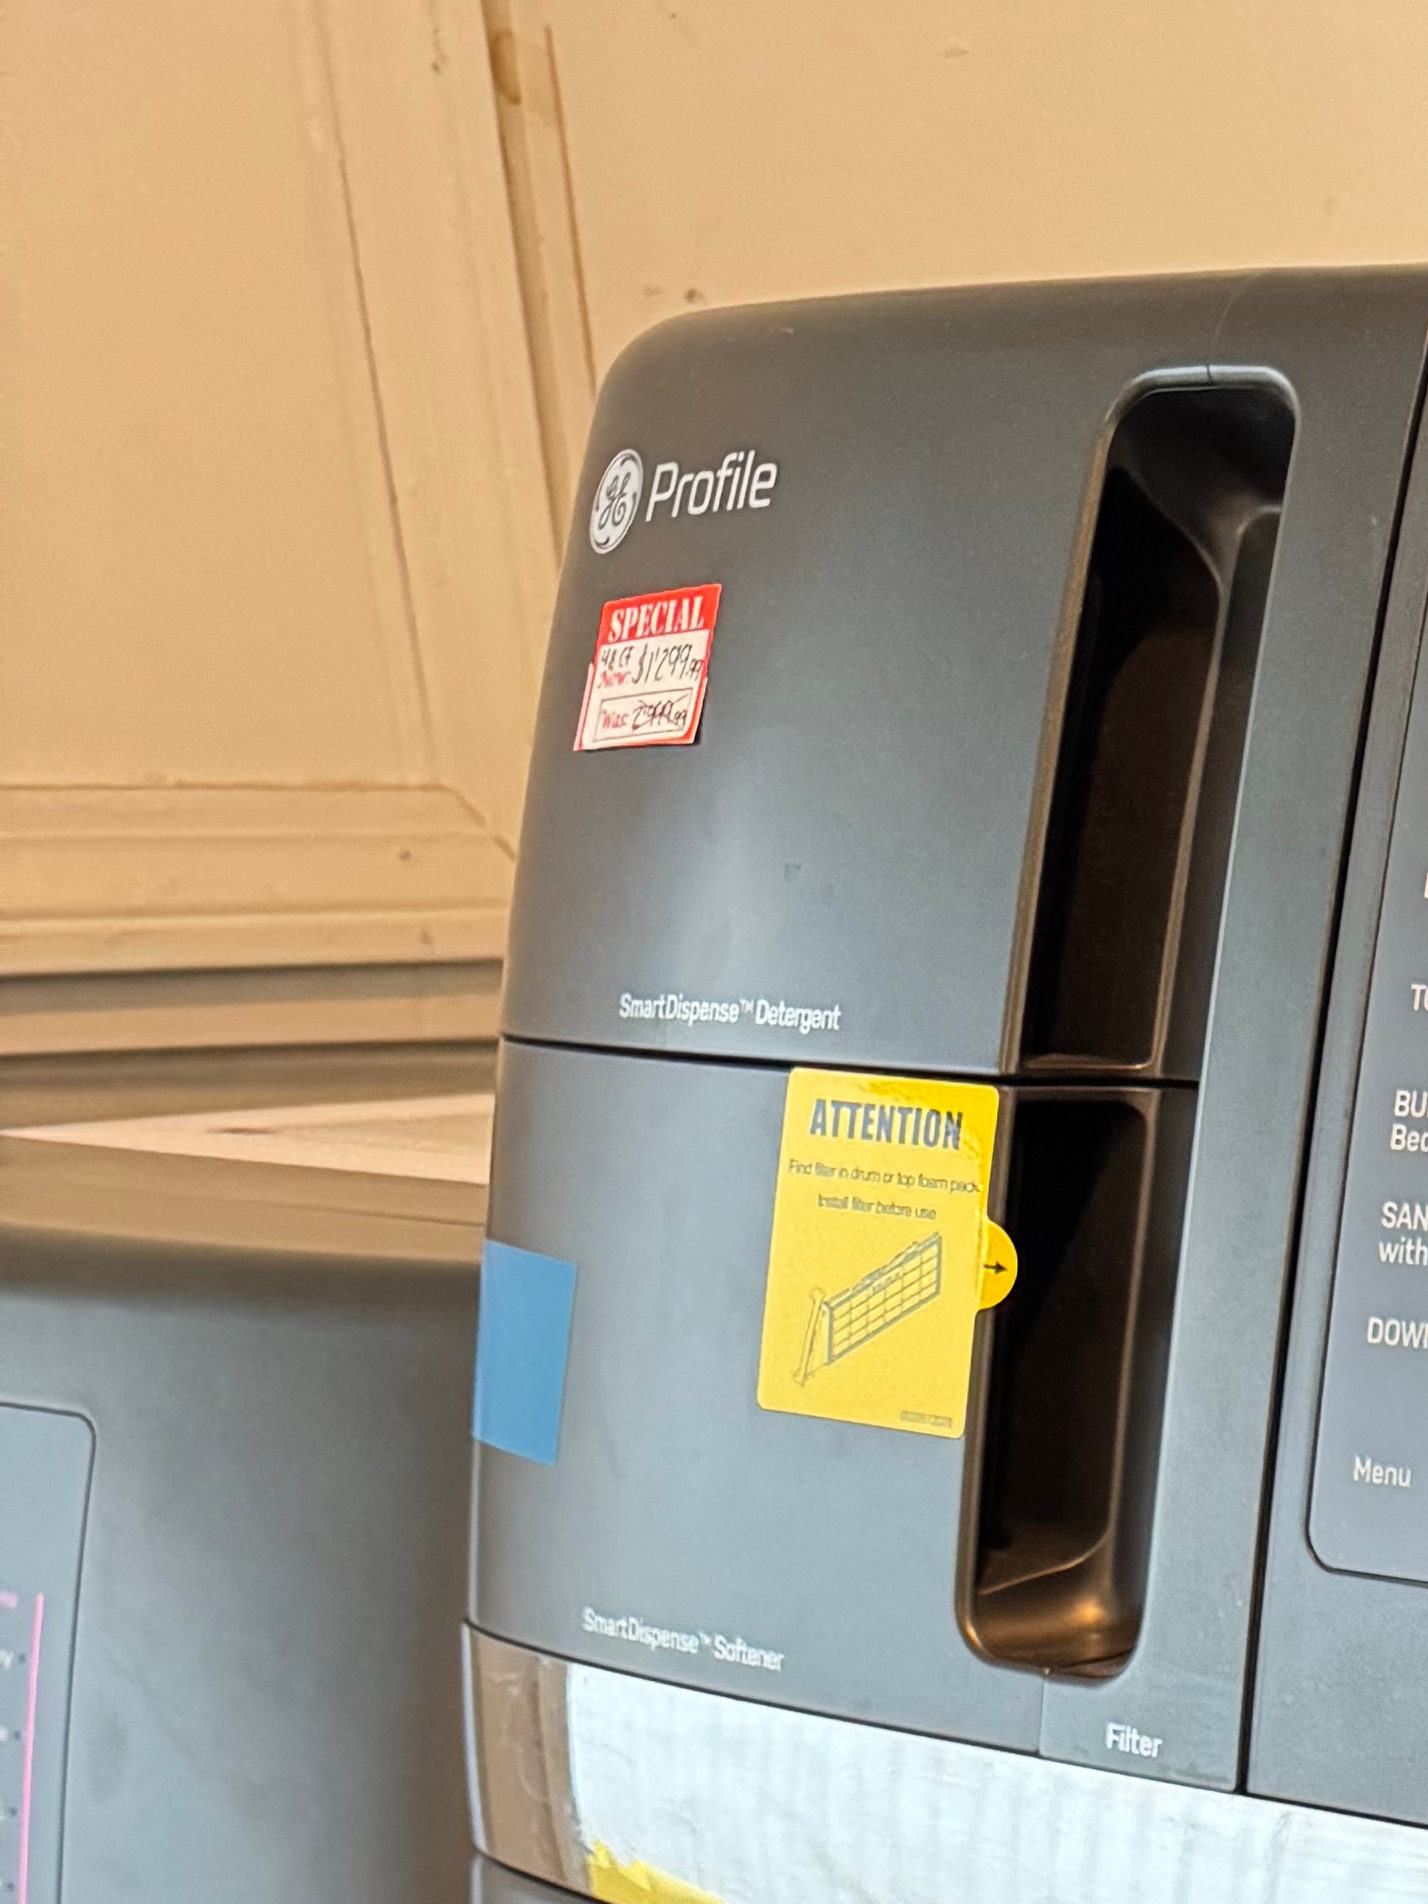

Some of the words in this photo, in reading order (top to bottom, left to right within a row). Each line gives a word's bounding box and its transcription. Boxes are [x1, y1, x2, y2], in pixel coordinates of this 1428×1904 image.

[645, 449, 777, 522] Profile
[609, 596, 704, 642] SPECIAL
[755, 999, 842, 1034] Detergent
[810, 1098, 963, 1151] ATTENTION
[788, 1159, 812, 1175] Find
[838, 1167, 849, 1179] in
[850, 1168, 881, 1183] drum
[882, 1173, 895, 1184] or
[897, 1172, 916, 1189] top
[917, 1173, 949, 1190] foam
[876, 1201, 913, 1218] before
[915, 1206, 937, 1220] use
[1379, 1238, 1428, 1265] with
[1354, 1456, 1411, 1487] Menu
[713, 1634, 785, 1673] Softener
[1105, 1721, 1163, 1758] Filter
